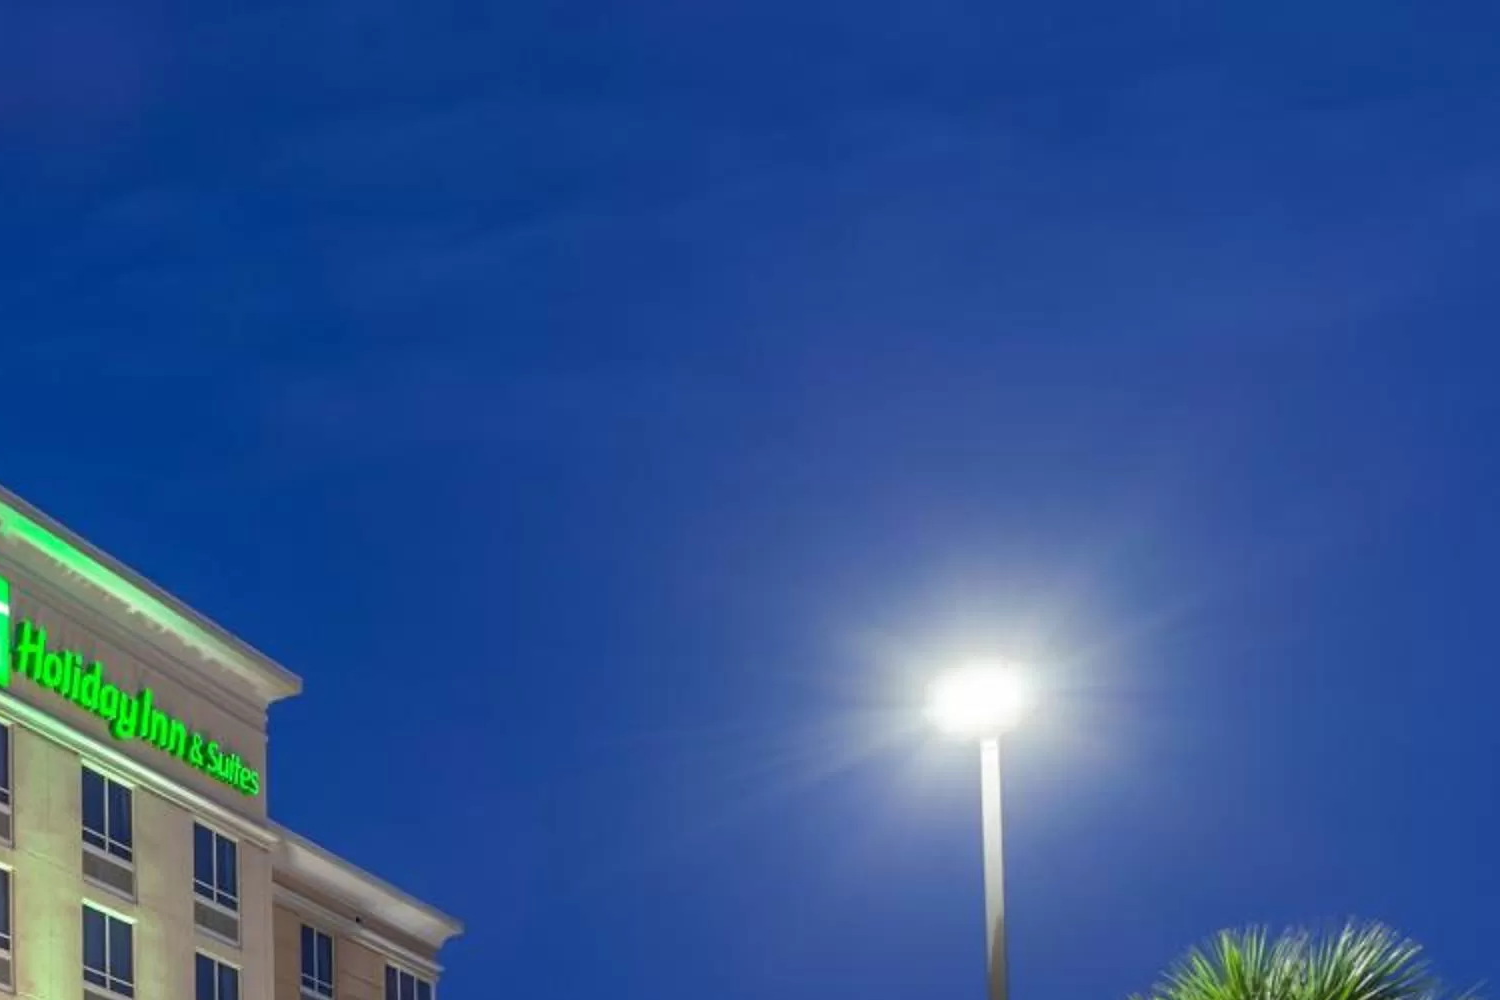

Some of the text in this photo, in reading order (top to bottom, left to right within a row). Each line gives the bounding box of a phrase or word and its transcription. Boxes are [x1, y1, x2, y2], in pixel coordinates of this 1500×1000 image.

[15, 618, 259, 795] Holiday Inn & Suites
